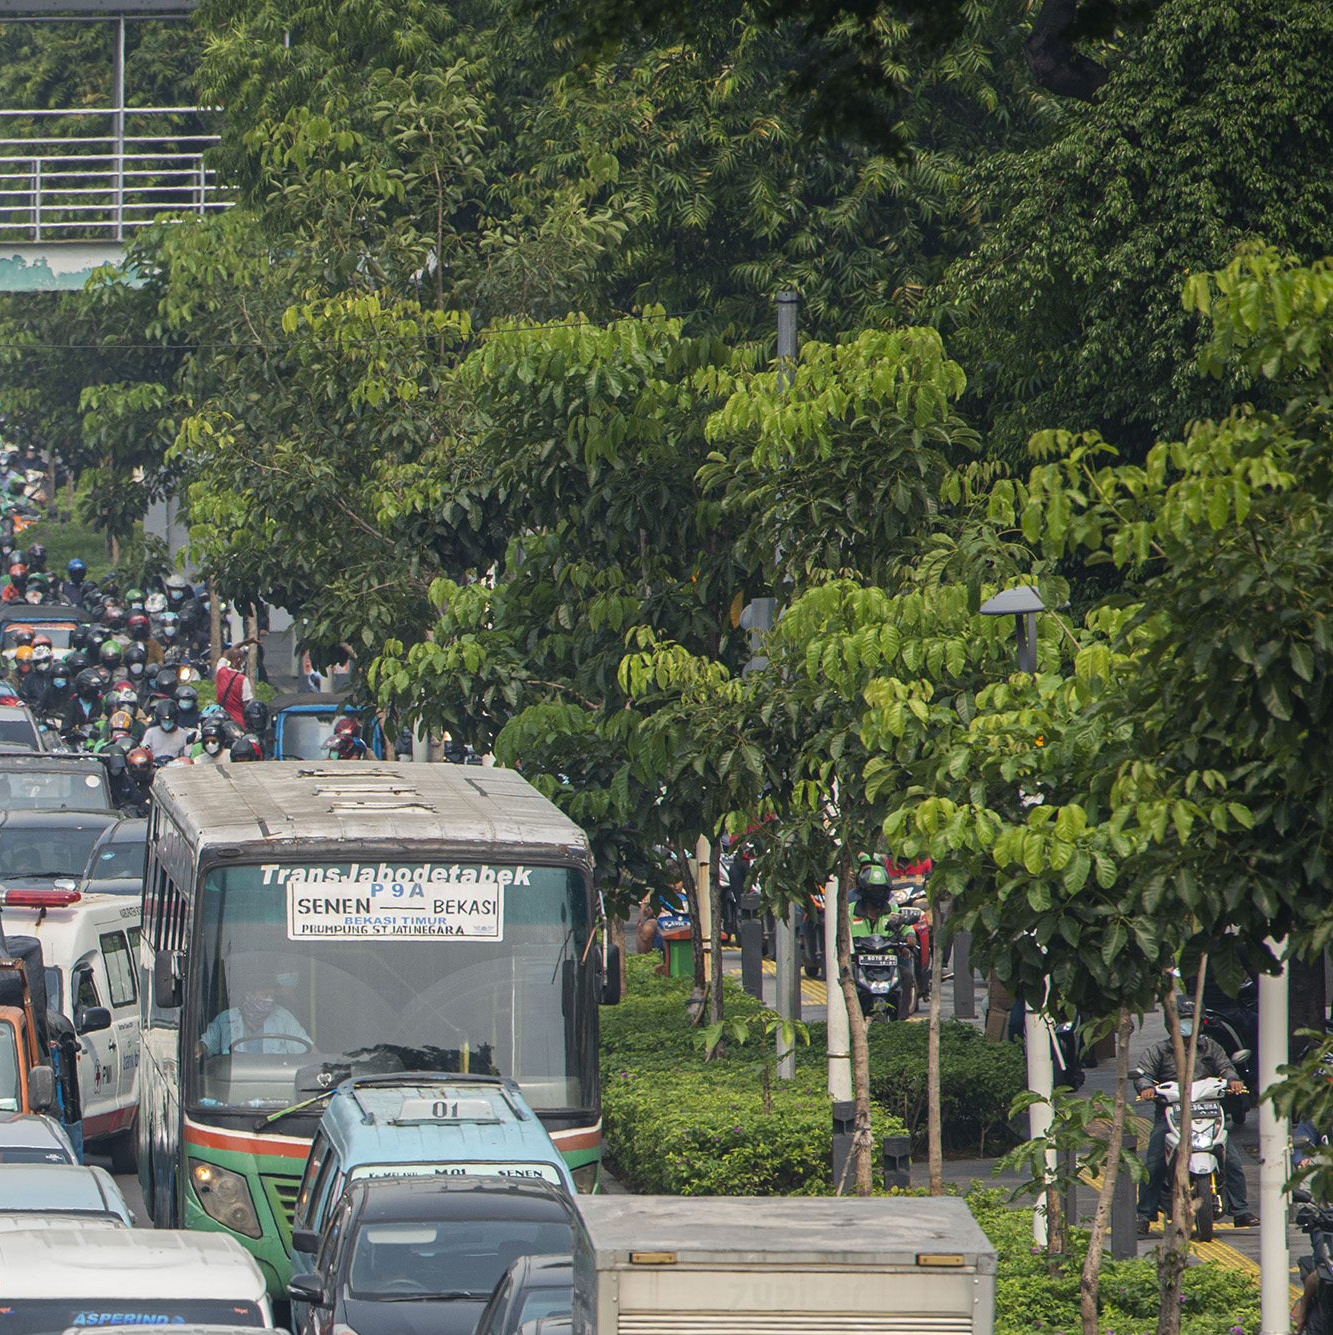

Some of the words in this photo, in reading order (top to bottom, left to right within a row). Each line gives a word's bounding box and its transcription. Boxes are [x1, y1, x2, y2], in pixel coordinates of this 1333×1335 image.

[260, 863, 533, 886] TransJabodetabek
[298, 897, 371, 915] SENEN
[433, 899, 497, 916] BEKASI
[344, 916, 397, 926] BEKASI
[401, 916, 447, 926] TIMUR
[431, 1101, 459, 1118] 01
